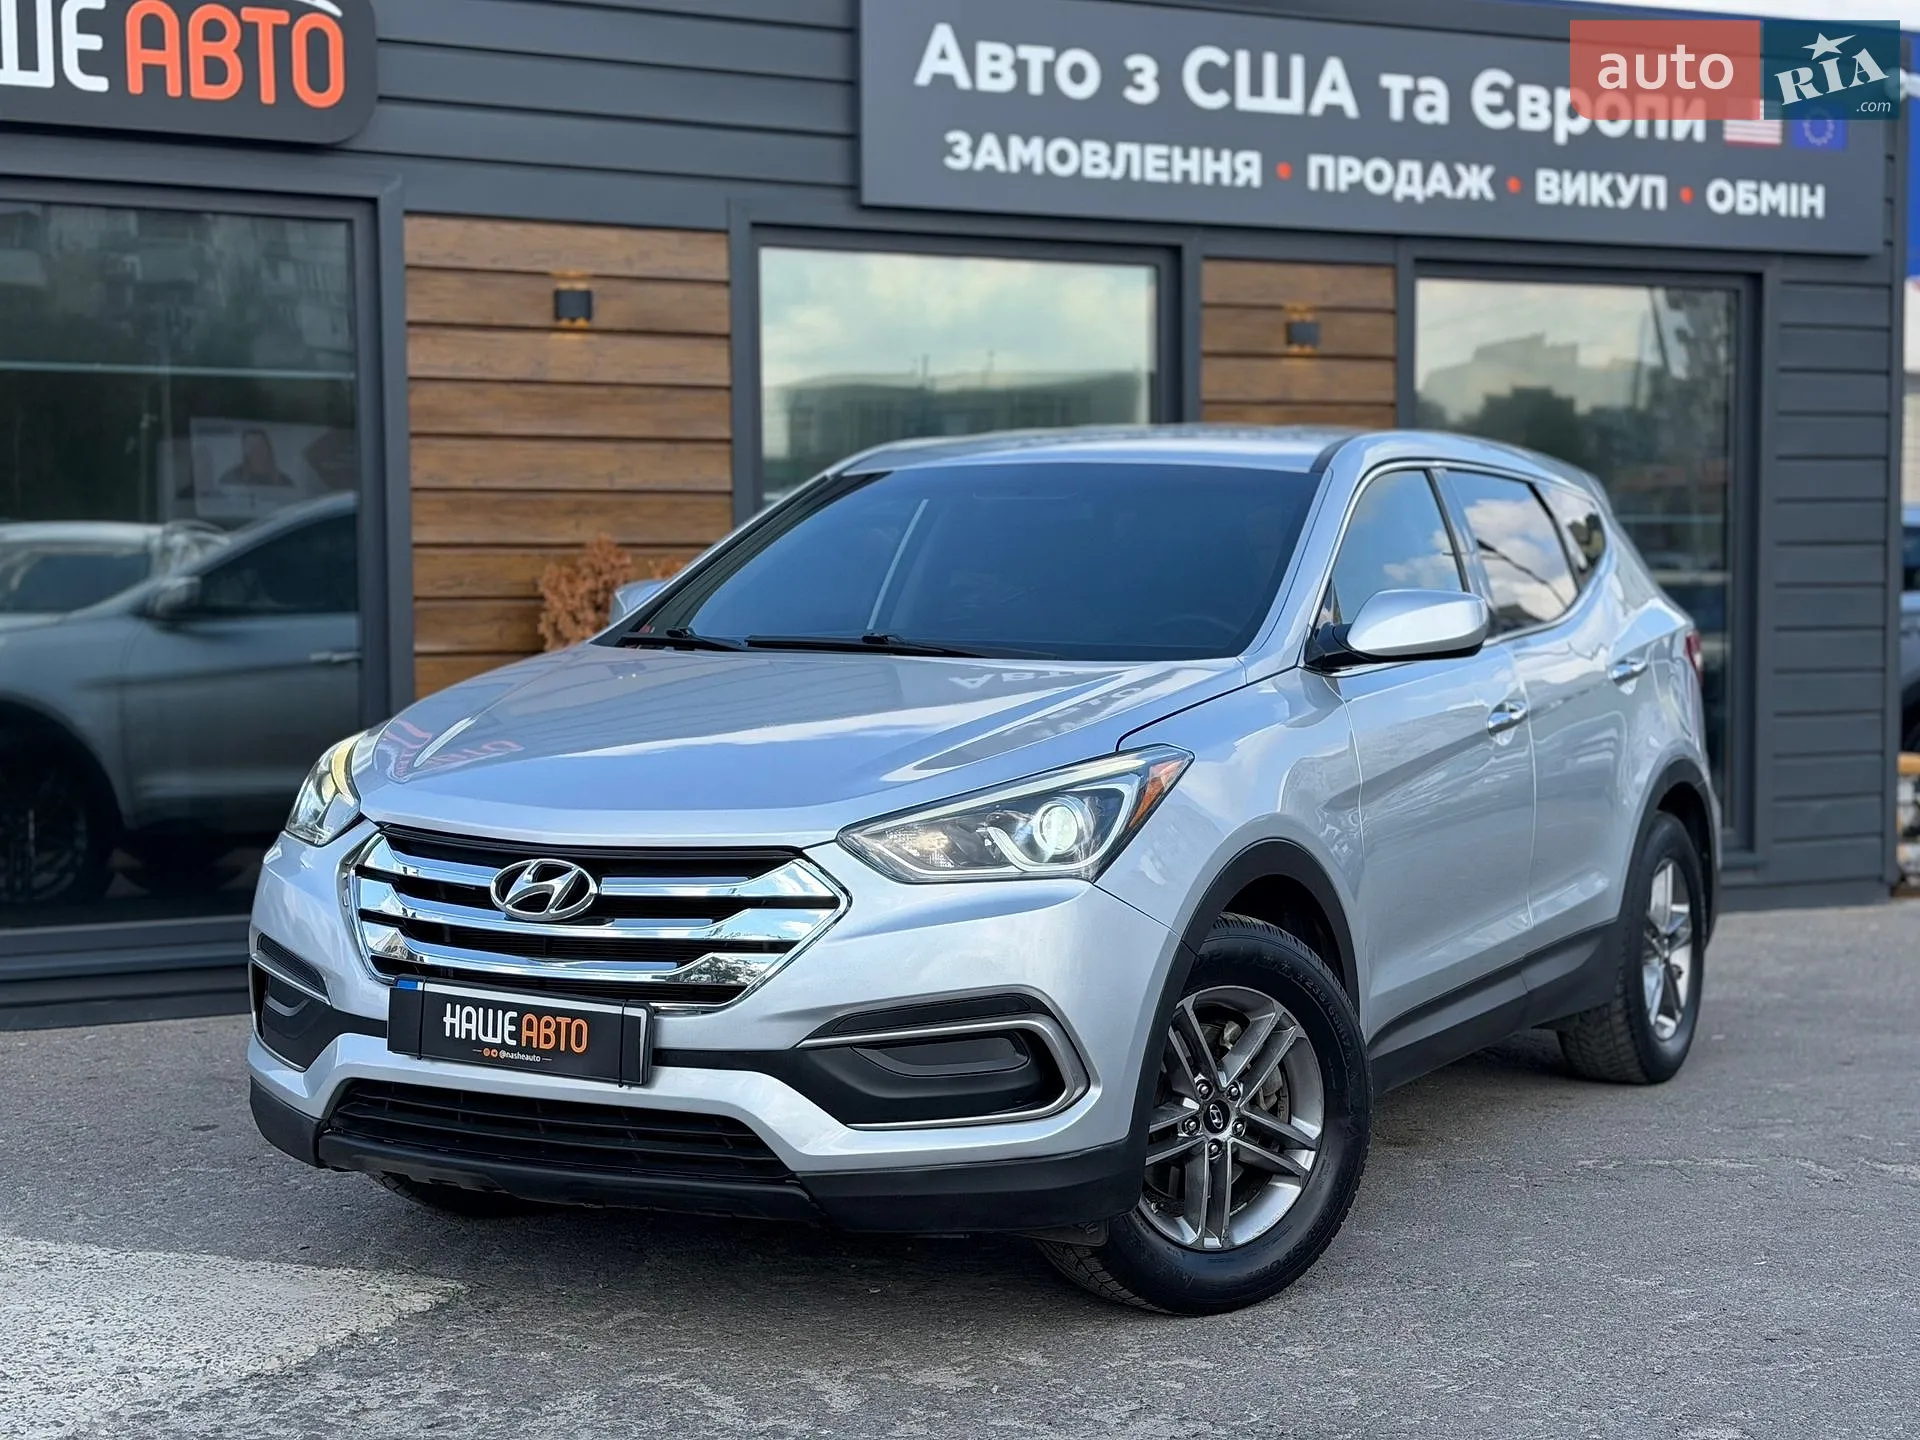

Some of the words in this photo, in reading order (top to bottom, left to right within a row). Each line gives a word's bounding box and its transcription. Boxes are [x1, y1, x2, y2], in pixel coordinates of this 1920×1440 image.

[125, 0, 345, 109] АВТО
[913, 22, 1102, 101] Авто
[1122, 53, 1161, 105] з
[1181, 45, 1360, 119] США
[1379, 72, 1451, 125] та
[1470, 67, 1707, 145] Європи
[943, 129, 1263, 189] ЗАМОВЛЕННЯ
[1306, 153, 1496, 203] ПРОДАЖ
[1535, 168, 1668, 210] ВИКУП
[1706, 179, 1826, 219] ОБМІН
[443, 1003, 518, 1046] НАШЕ
[521, 1013, 588, 1053] АВТО
[499, 1049, 541, 1062] @nasheauto
